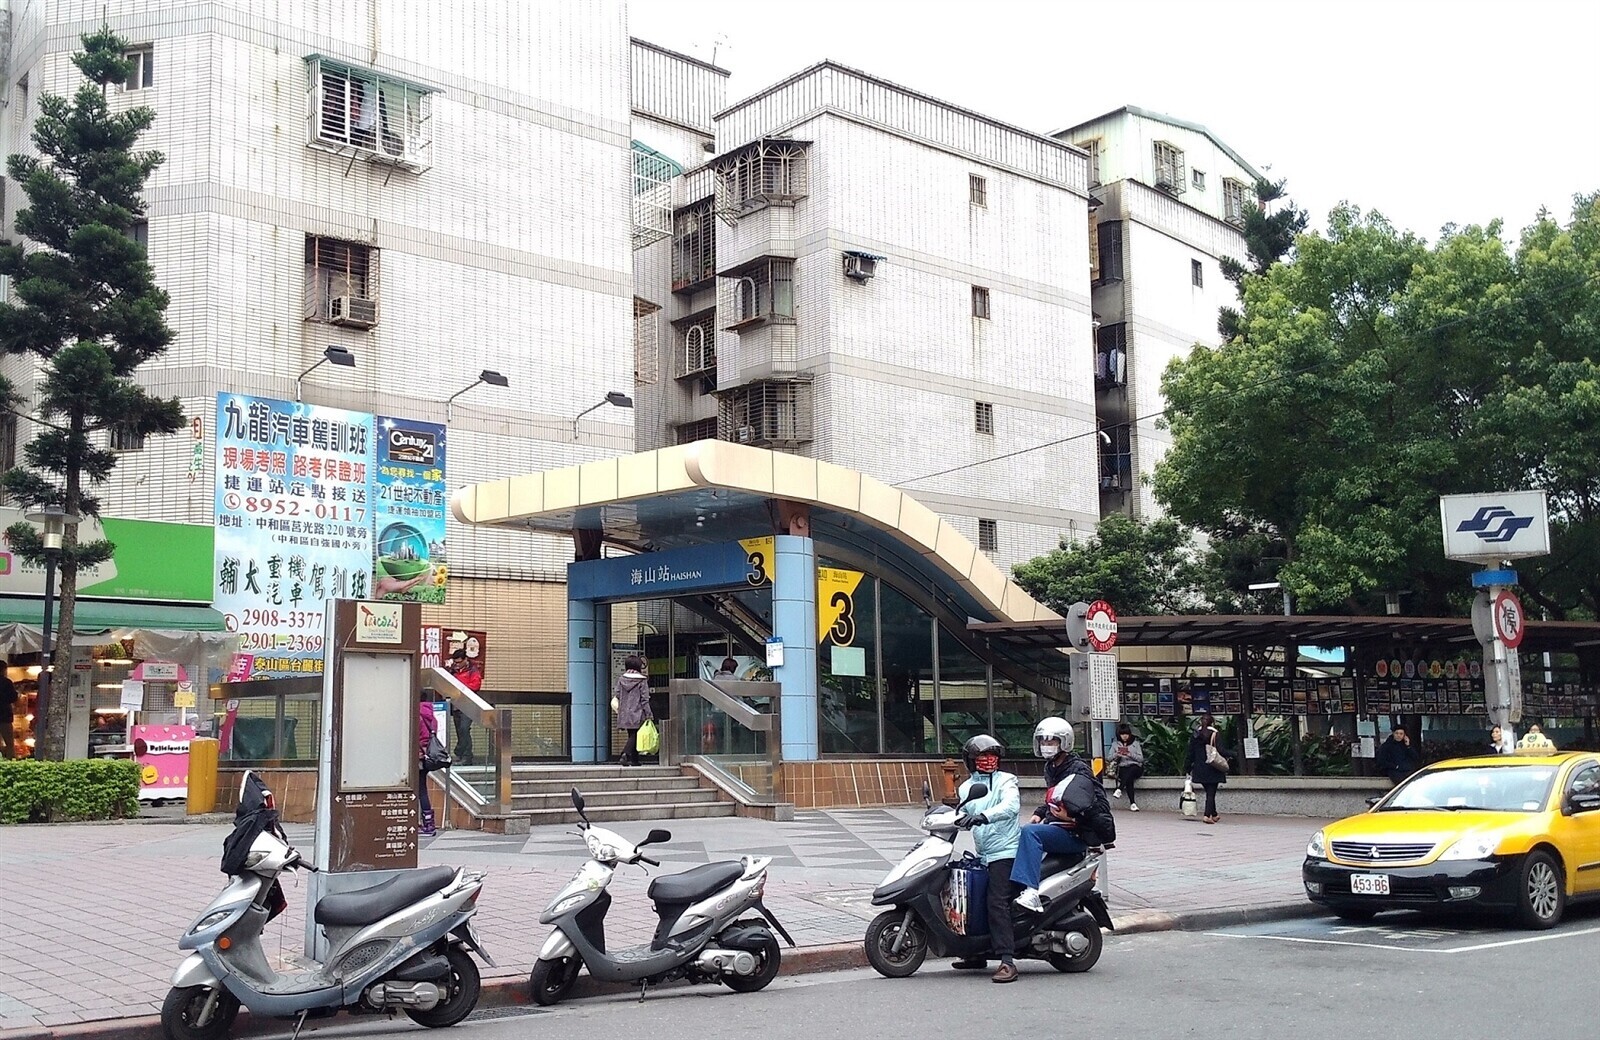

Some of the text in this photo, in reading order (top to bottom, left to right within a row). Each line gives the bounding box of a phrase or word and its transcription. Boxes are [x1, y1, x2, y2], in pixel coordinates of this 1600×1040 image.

[224, 400, 367, 455] 九龍汽車駕訓班
[390, 431, 434, 458] Century 21
[223, 447, 287, 474] 現場考照
[293, 454, 366, 484] 路考保證班
[224, 474, 366, 504] 捷運站定點接送
[381, 485, 442, 506] 21世紀不動產
[245, 496, 365, 522] 8952-0117
[630, 564, 702, 585] 海山站 HAISHAN
[747, 551, 766, 587] 3
[242, 609, 323, 629] 2908-3377
[829, 590, 855, 647] 3
[1503, 606, 1517, 633] 停
[241, 632, 322, 651] 2901-2369
[1353, 879, 1388, 891] 453-B6
